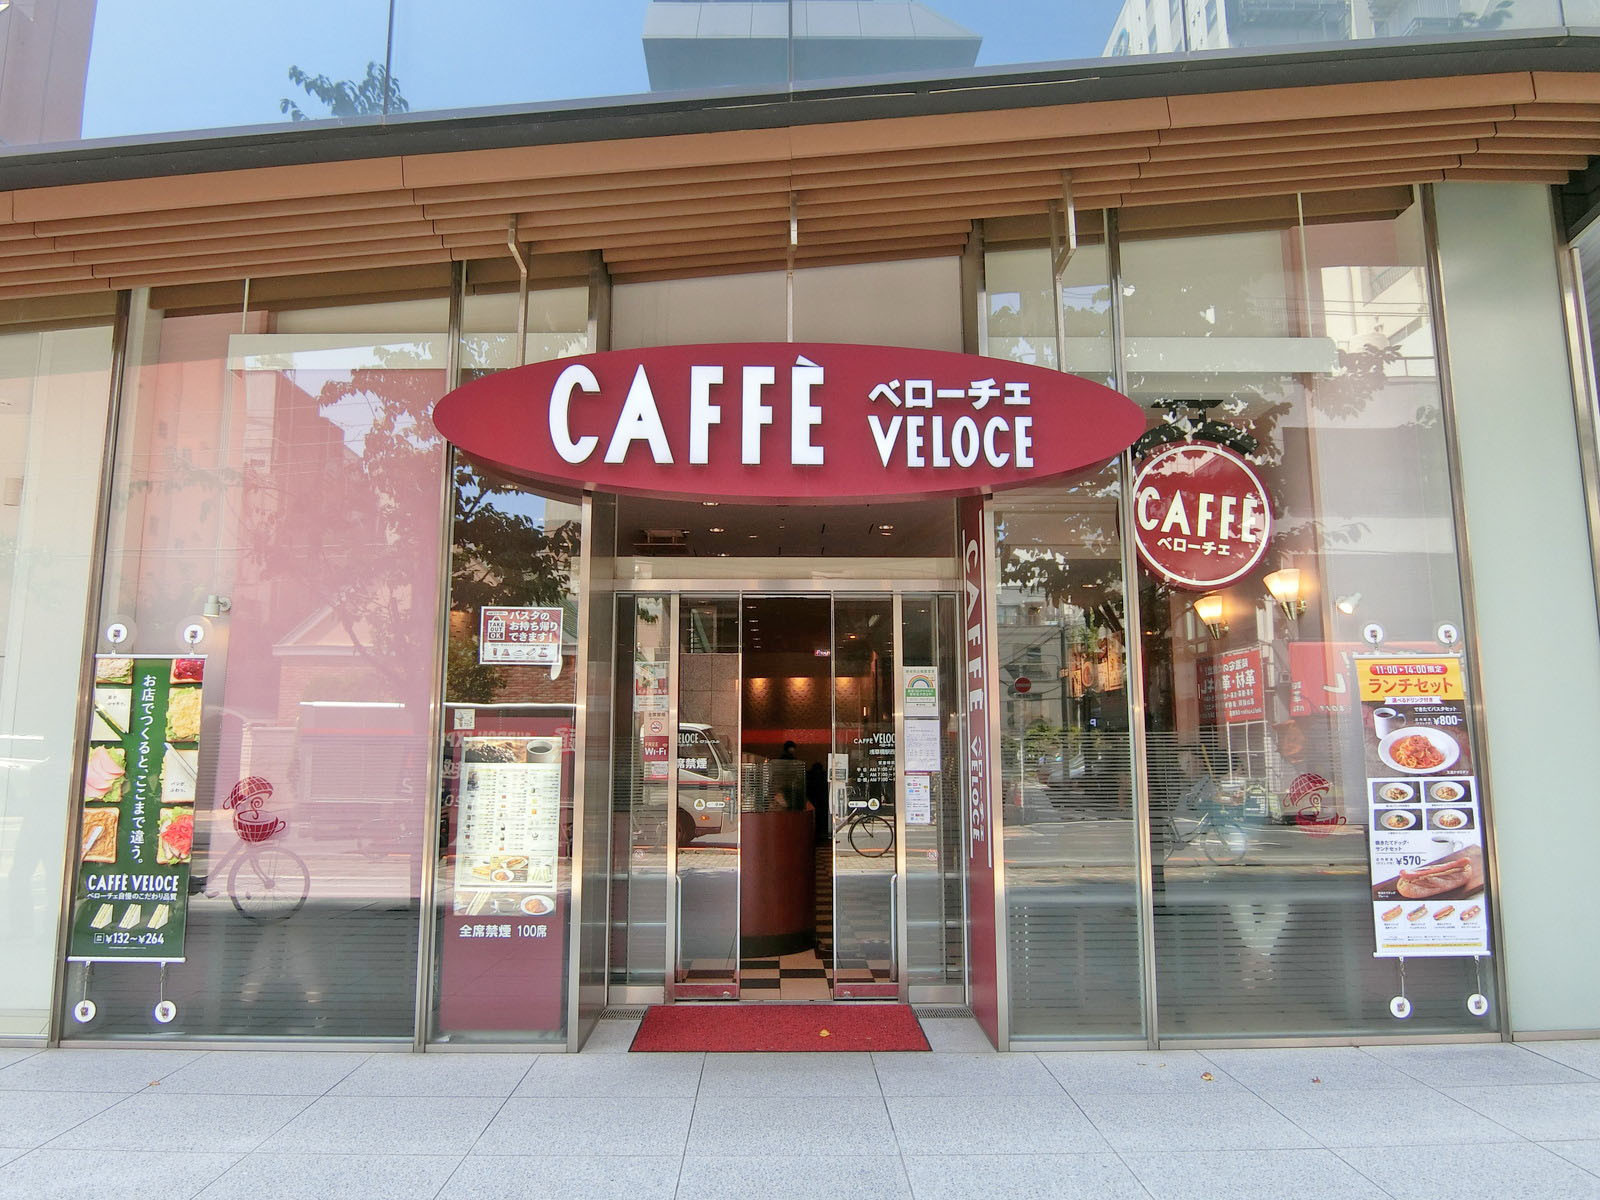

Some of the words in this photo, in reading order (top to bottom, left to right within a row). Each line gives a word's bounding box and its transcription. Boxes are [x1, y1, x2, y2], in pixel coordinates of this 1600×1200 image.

[868, 378, 1032, 412] ベローチェ
[548, 354, 825, 466] CAFFÈ
[868, 415, 1035, 469] VELOCE
[1137, 486, 1258, 544] CAFFÈ
[1156, 537, 1231, 556] ベローチェ
[509, 611, 550, 621] パスタの
[508, 621, 558, 632] お持ち帰り
[1368, 677, 1453, 694] ランチセット
[645, 747, 667, 755] Wi-Fi
[130, 674, 157, 864] お店でつくると、ここまで違う。
[970, 735, 981, 842] VELOCE
[131, 875, 180, 892] VELOCE
[86, 892, 178, 901] ベローチェ自慢のこだわり品質
[459, 924, 512, 938] 全席禁煙
[516, 924, 548, 938] 100席
